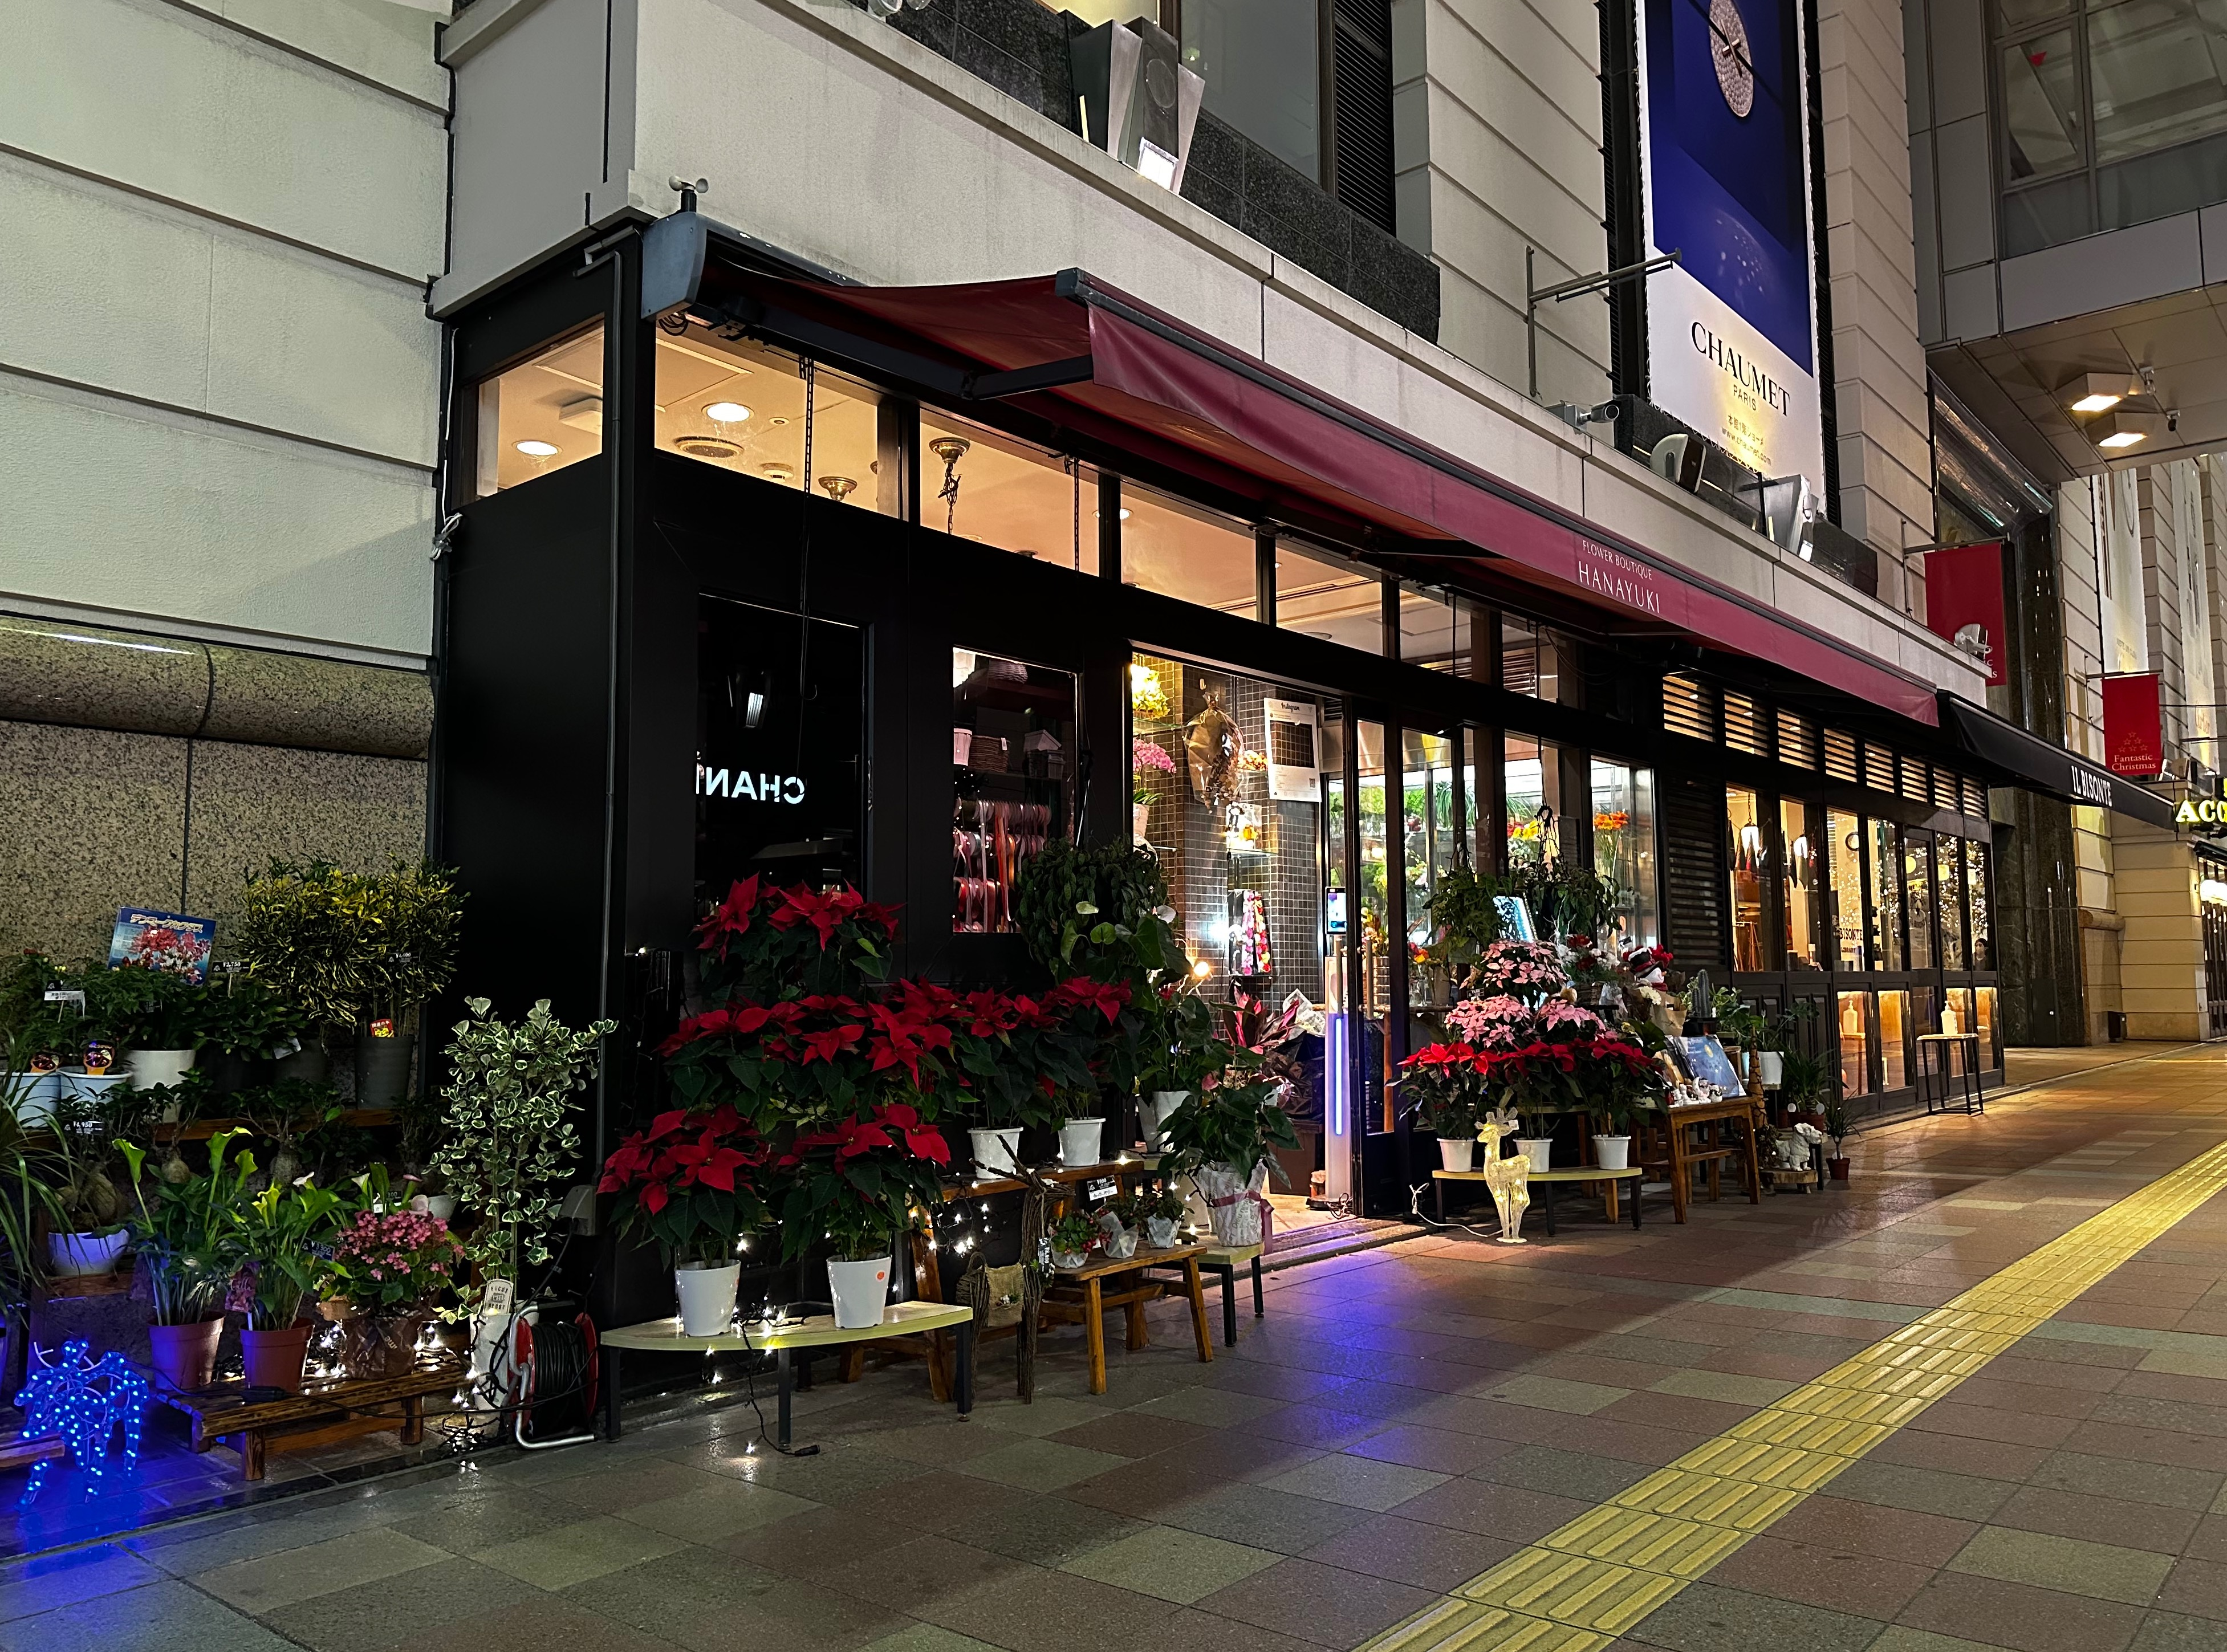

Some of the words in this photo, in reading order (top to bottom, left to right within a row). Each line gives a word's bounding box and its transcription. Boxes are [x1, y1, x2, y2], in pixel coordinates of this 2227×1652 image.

[1692, 322, 1790, 417] CHAUMET
[1733, 384, 1757, 411] PARIS
[1583, 540, 1613, 564] FLOWER
[1615, 554, 1652, 580] BOUTIQUE
[1579, 561, 1660, 613] HANAYUKI
[2112, 763, 2156, 771] Christmas
[2114, 754, 2153, 763] Fantastic
[2071, 766, 2081, 795] IL
[2080, 770, 2112, 807] BISONTE
